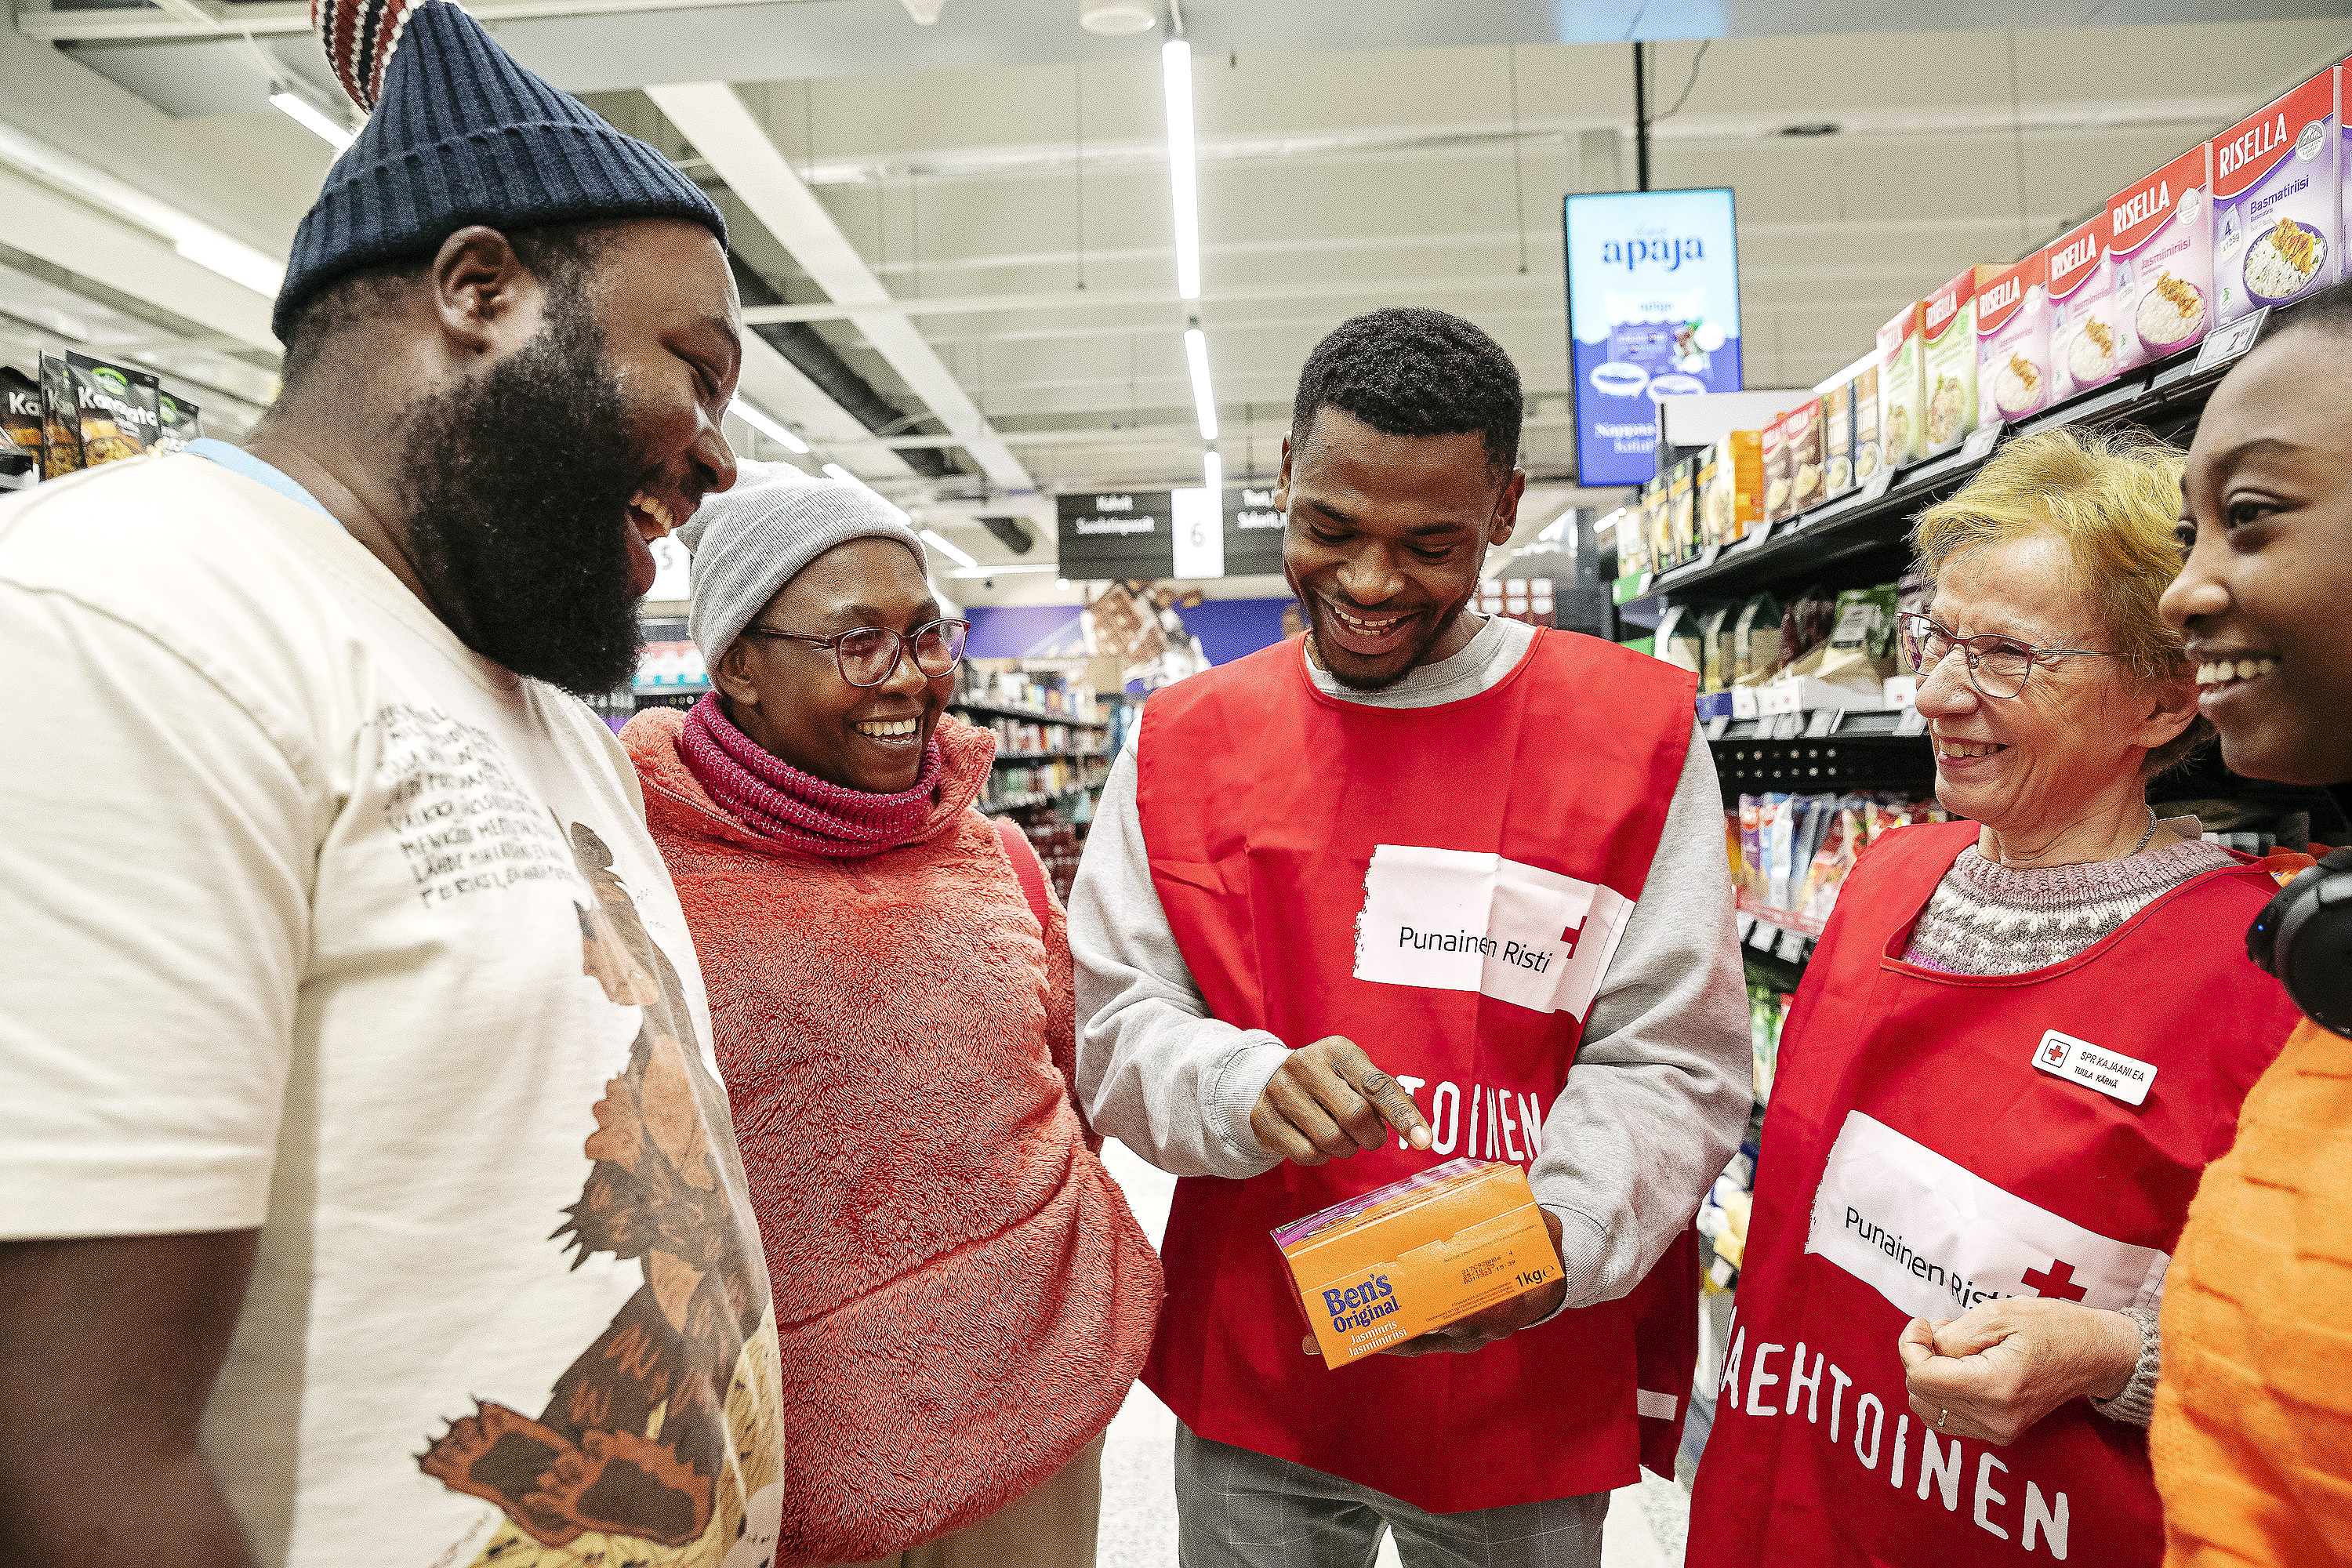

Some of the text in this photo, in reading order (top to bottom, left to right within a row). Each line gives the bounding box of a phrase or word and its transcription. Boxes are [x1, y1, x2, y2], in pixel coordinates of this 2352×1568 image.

[2219, 112, 2288, 179] RISELLA
[2112, 180, 2171, 237] RISELLA
[2250, 174, 2310, 215] Basmatiriisi
[1602, 237, 1705, 272] apaja
[2051, 234, 2098, 282] RISELLA
[1978, 275, 2022, 320] RISELLA
[1189, 521, 1206, 547] 6
[661, 544, 674, 571] 5
[1399, 926, 1552, 974] Punainen Risti
[2074, 1065, 2092, 1080] TUULA
[2080, 1051, 2144, 1082] SPR KAJAANI EA
[1845, 1206, 2015, 1310] Punainen Ris
[1322, 1273, 1392, 1317] Ben's
[1515, 1269, 1543, 1287] 1kg
[1333, 1294, 1400, 1333] Original
[1351, 1320, 1398, 1345] Jasminris
[1348, 1326, 1407, 1358] Jasmiiniriisi
